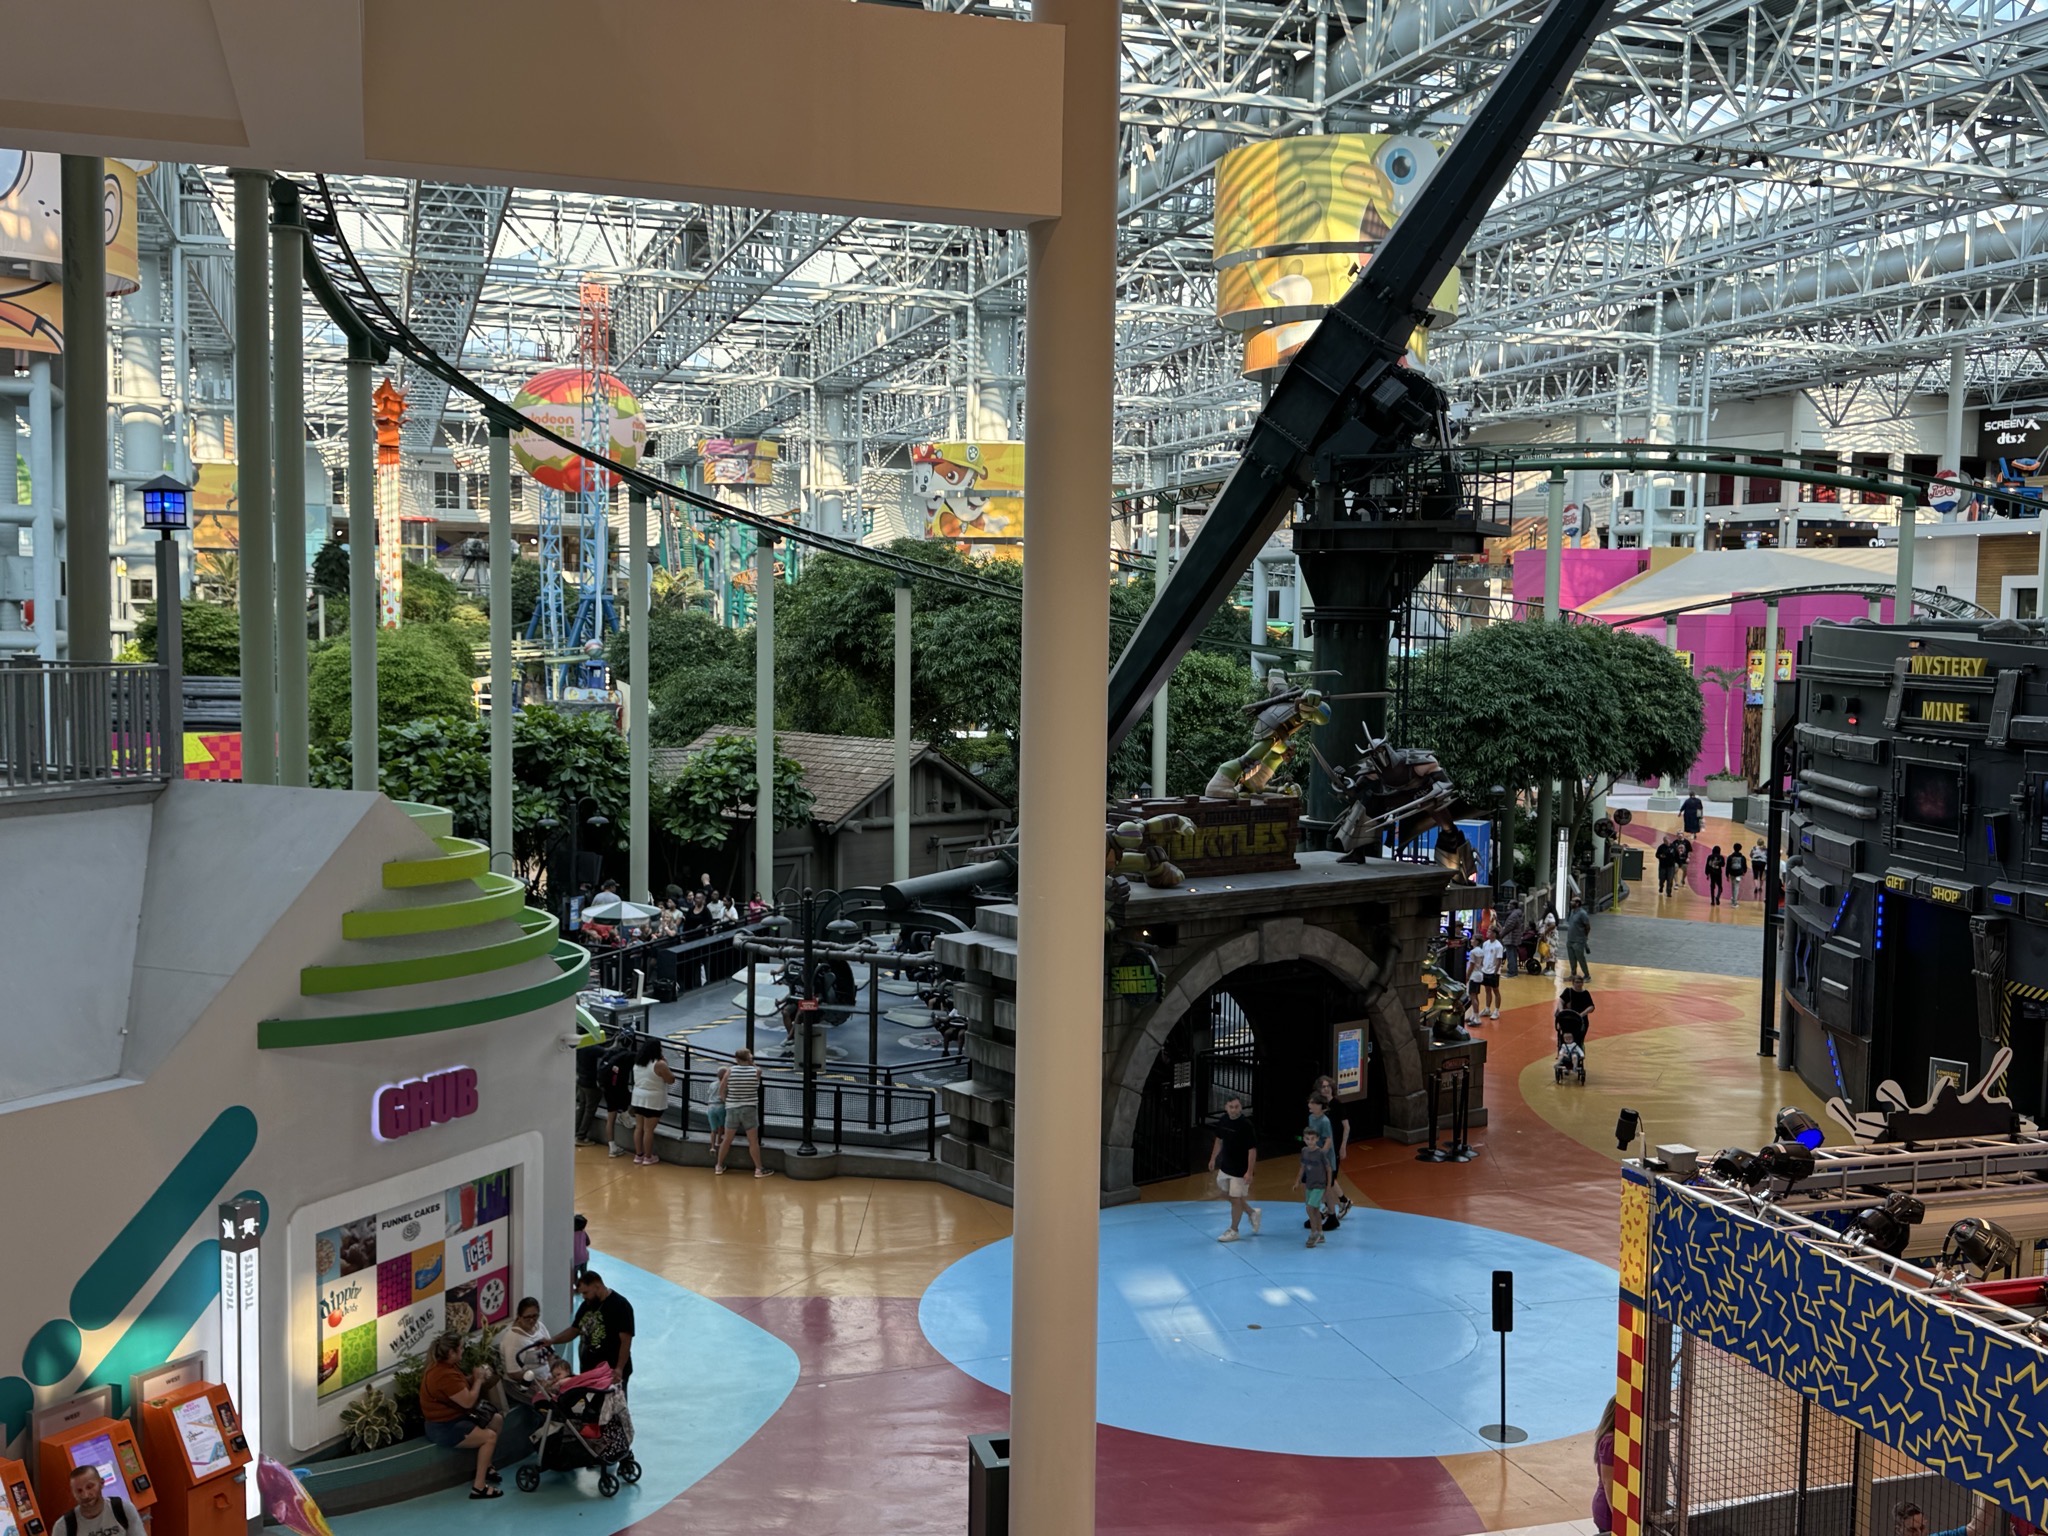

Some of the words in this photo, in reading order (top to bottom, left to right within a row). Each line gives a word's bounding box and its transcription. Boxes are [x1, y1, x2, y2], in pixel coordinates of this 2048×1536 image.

[1911, 655, 1988, 677] MYSTERY
[1922, 700, 1970, 723] MINE
[1885, 875, 1905, 890] GIFT
[1931, 886, 1961, 903] SHOP
[1111, 965, 1155, 980] SHELL
[1111, 979, 1158, 994] SHOCK
[375, 1067, 479, 1140] GRUB
[381, 1213, 413, 1230] FUNNEL
[414, 1203, 441, 1219] CAKES
[467, 1237, 491, 1268] ICEE
[226, 1255, 234, 1310] TICKETS
[244, 1253, 254, 1310] TICKETS
[389, 1308, 435, 1353] WALKING
[165, 1375, 181, 1385] WEST
[64, 1411, 81, 1422] WEST
